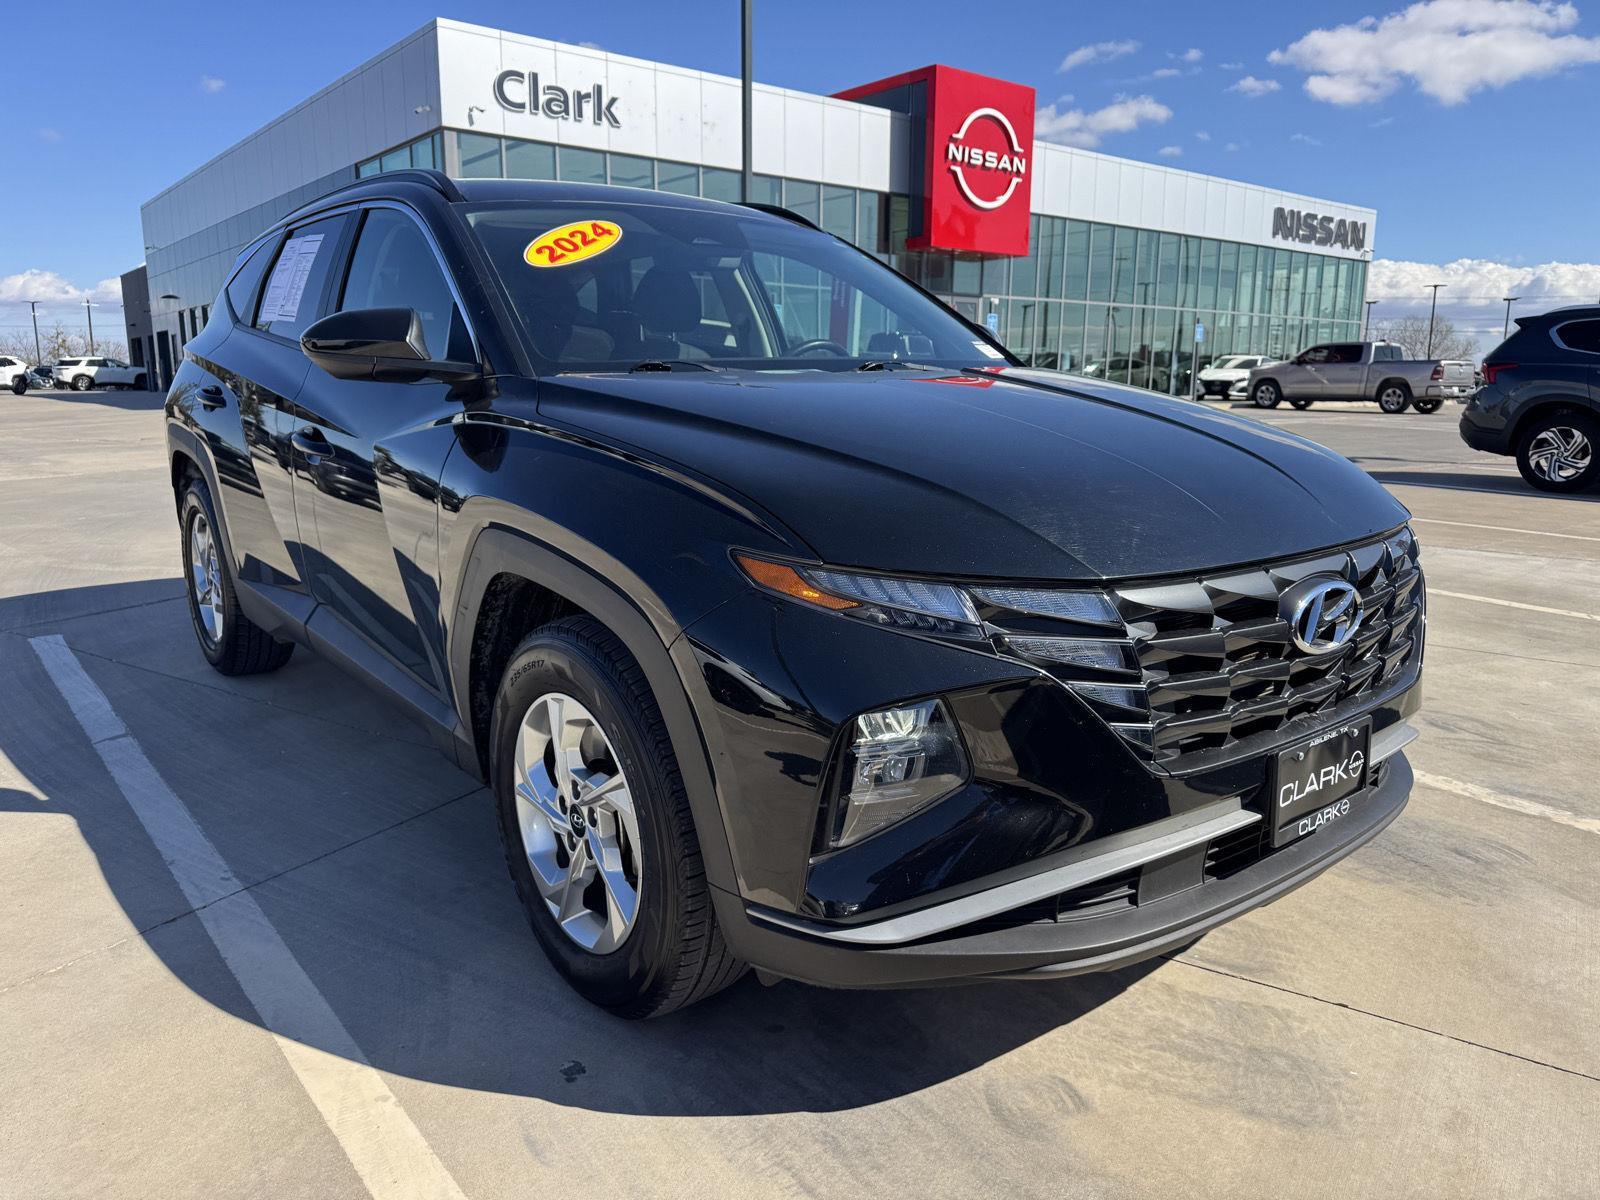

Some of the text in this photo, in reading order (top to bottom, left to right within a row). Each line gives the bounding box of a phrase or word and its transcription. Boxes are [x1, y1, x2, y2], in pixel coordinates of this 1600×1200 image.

[494, 70, 621, 128] Clark
[947, 142, 1026, 174] NISSAN
[535, 223, 614, 263] 2024
[1272, 206, 1366, 251] NISSAN
[1280, 758, 1348, 807] CLARK
[1298, 803, 1341, 835] CLARK
